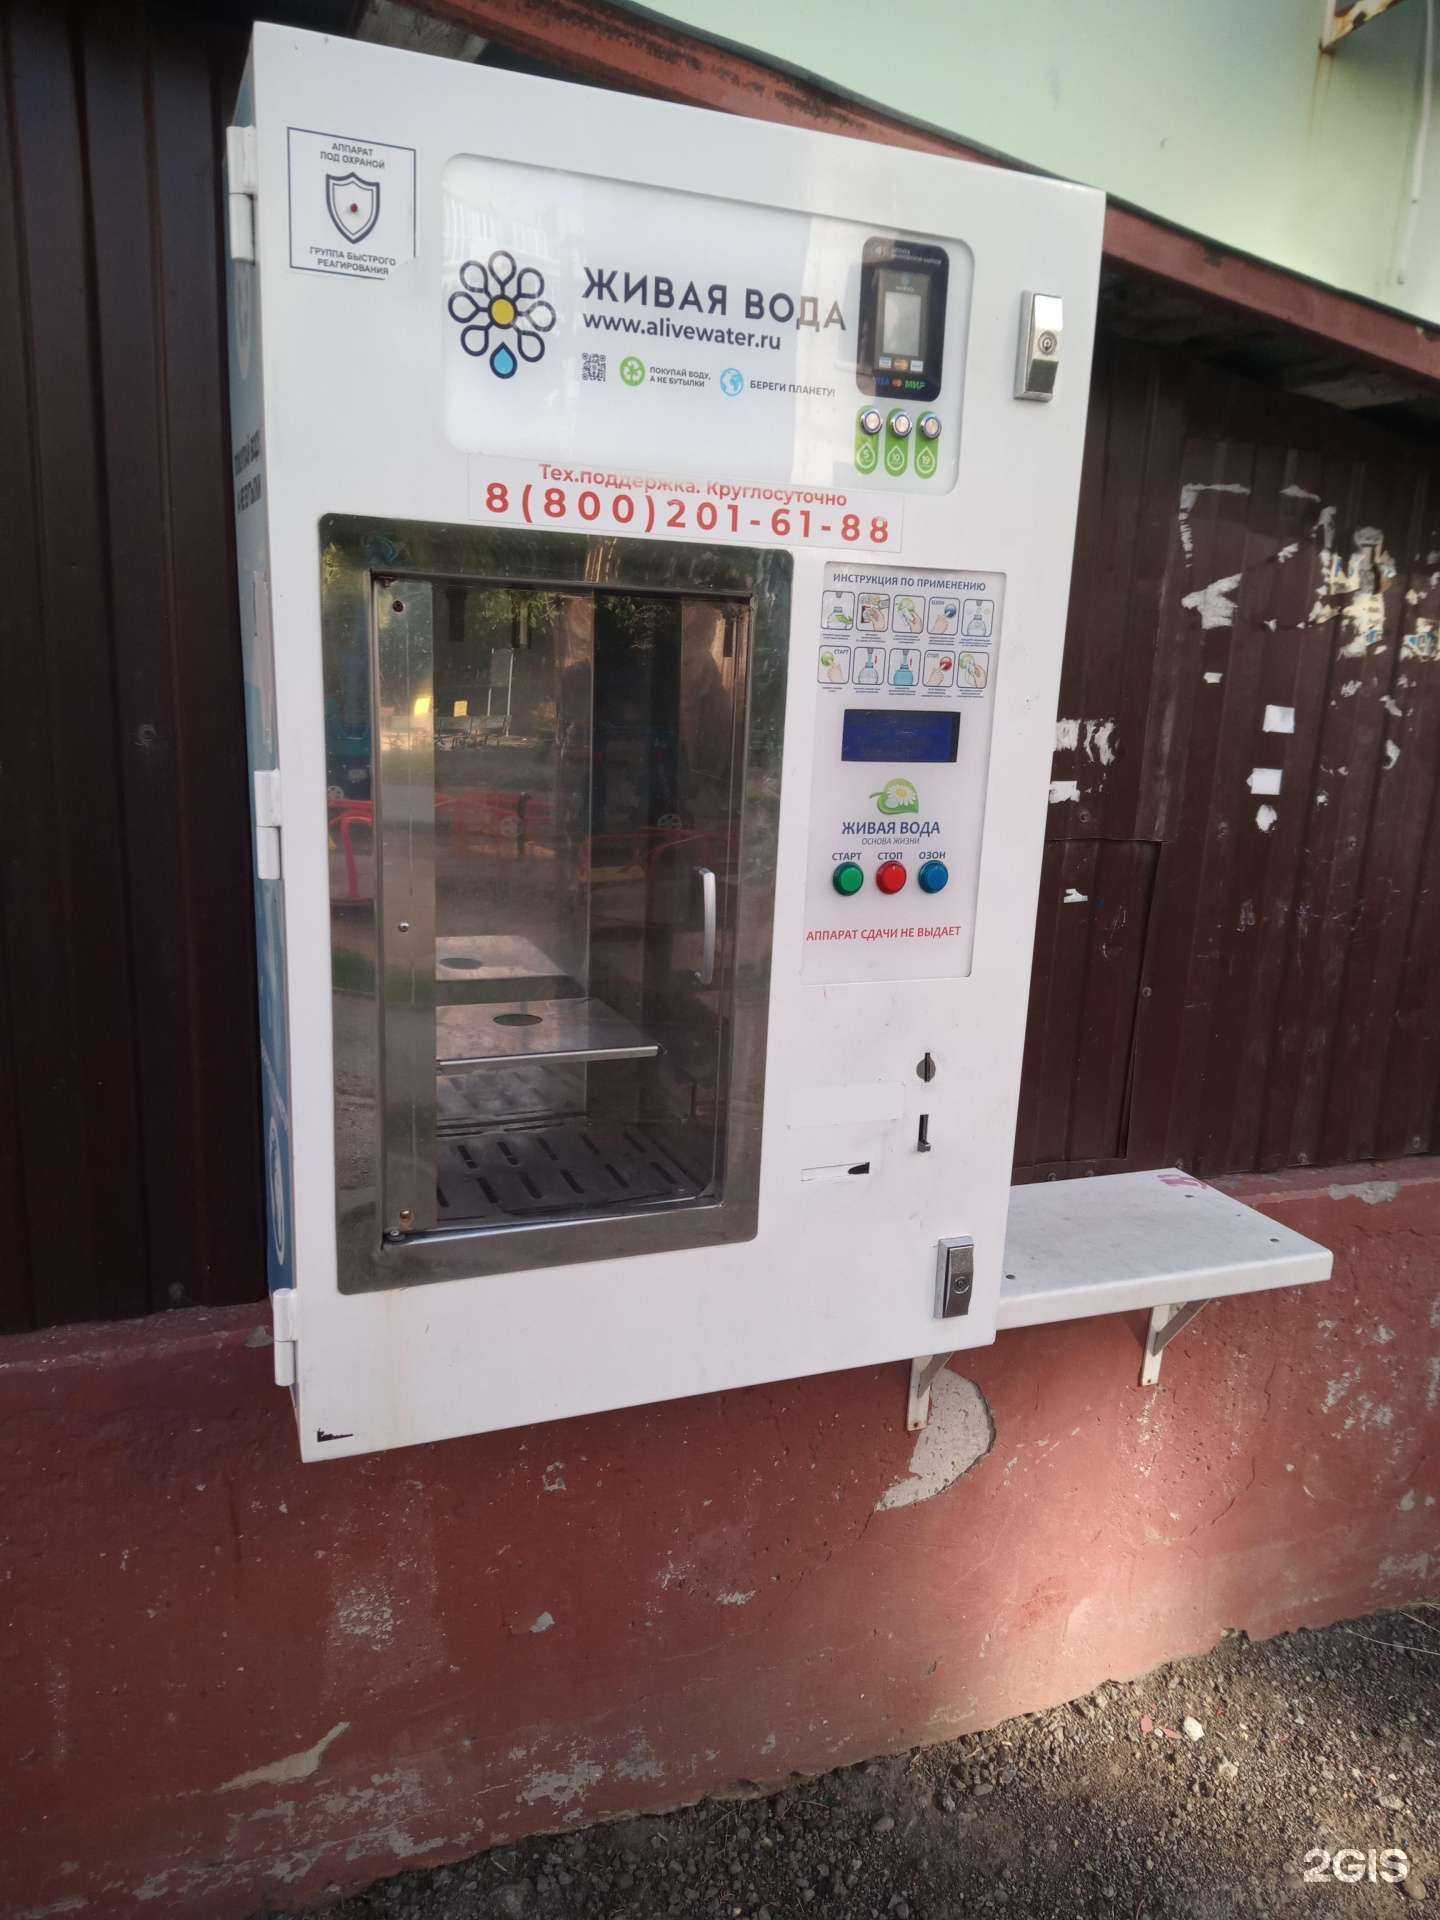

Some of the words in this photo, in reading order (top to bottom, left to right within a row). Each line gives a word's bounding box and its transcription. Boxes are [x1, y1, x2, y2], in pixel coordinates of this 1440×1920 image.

[331, 142, 373, 156] АППАРАТ
[320, 151, 340, 162] ПОД
[342, 154, 385, 169] ОХРАНОЙ
[309, 246, 344, 259] ГРУППА
[346, 252, 396, 266] БЫСТРОГО
[317, 258, 389, 276] РЕАГИРОВАНИЯ
[581, 266, 728, 316] ЖИВАЯ
[745, 287, 847, 332] ВОДА
[582, 313, 782, 350] www.alivewater.ru
[649, 366, 687, 377] ПОКУПАЙ
[688, 370, 711, 381] ВОДУ,
[649, 375, 656, 383] А
[657, 376, 668, 384] НЕ
[669, 376, 705, 388] БУТЫЛКИ
[749, 379, 786, 393] БЕРЕГИ
[788, 384, 836, 398] ПЛАНЕТУ!
[538, 463, 701, 495] Тех.поддержка.
[706, 480, 848, 508] Круглосуточно
[486, 482, 889, 544] 8(800)201-61-88
[833, 573, 898, 586] ИНСТРУКЦИЯ
[901, 577, 914, 588] ПО
[916, 578, 986, 591] ПРИМЕНЕНИЮ
[842, 821, 896, 835] ЖИВАЯ
[900, 821, 941, 837] ВОДА
[861, 837, 892, 846] ОСНОВА
[893, 837, 920, 845] ЖИЗНИ
[832, 852, 863, 861] СТАРТ
[877, 851, 903, 860] СТОП
[918, 851, 946, 860] ОЗОН
[806, 930, 858, 941] АППАРАТ
[860, 928, 898, 941] СДАЧИ
[900, 927, 915, 938] НЕ
[917, 925, 962, 938] ВЫДАЕТ
